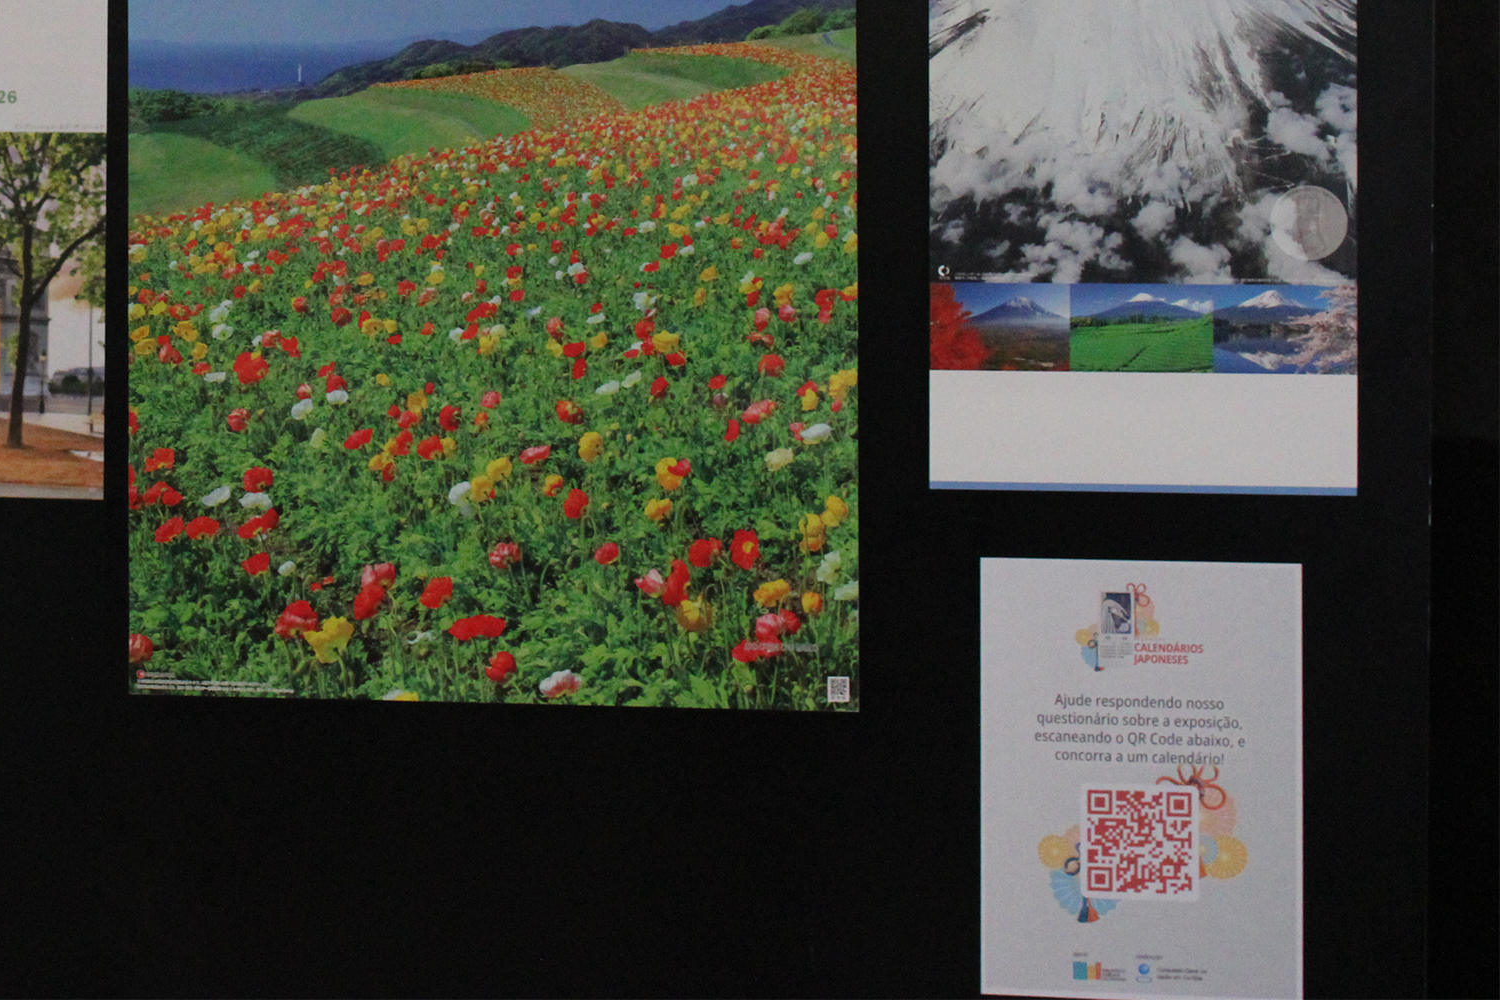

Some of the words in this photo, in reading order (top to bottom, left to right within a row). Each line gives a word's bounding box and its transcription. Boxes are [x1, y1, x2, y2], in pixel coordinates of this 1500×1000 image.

[1134, 642, 1204, 654] CALENDÁRIOS
[1133, 654, 1189, 665] JAPONESES
[1054, 694, 1092, 709] Ajude
[1096, 695, 1182, 711] respondendo
[1186, 698, 1224, 710] nosso
[1037, 712, 1119, 728] questionário
[1123, 714, 1159, 727] sobre
[1163, 718, 1170, 727] a
[1174, 715, 1243, 731] exposição,
[1034, 732, 1111, 744] escaneando
[1115, 735, 1123, 744] o
[1127, 732, 1147, 747] QR
[1150, 733, 1183, 746] Code
[1187, 734, 1234, 749] abaixo,
[1238, 738, 1245, 747] e
[1055, 750, 1113, 761] concorra
[1116, 753, 1124, 762] a
[1127, 753, 1148, 762] um
[1151, 750, 1224, 765] calendário!
